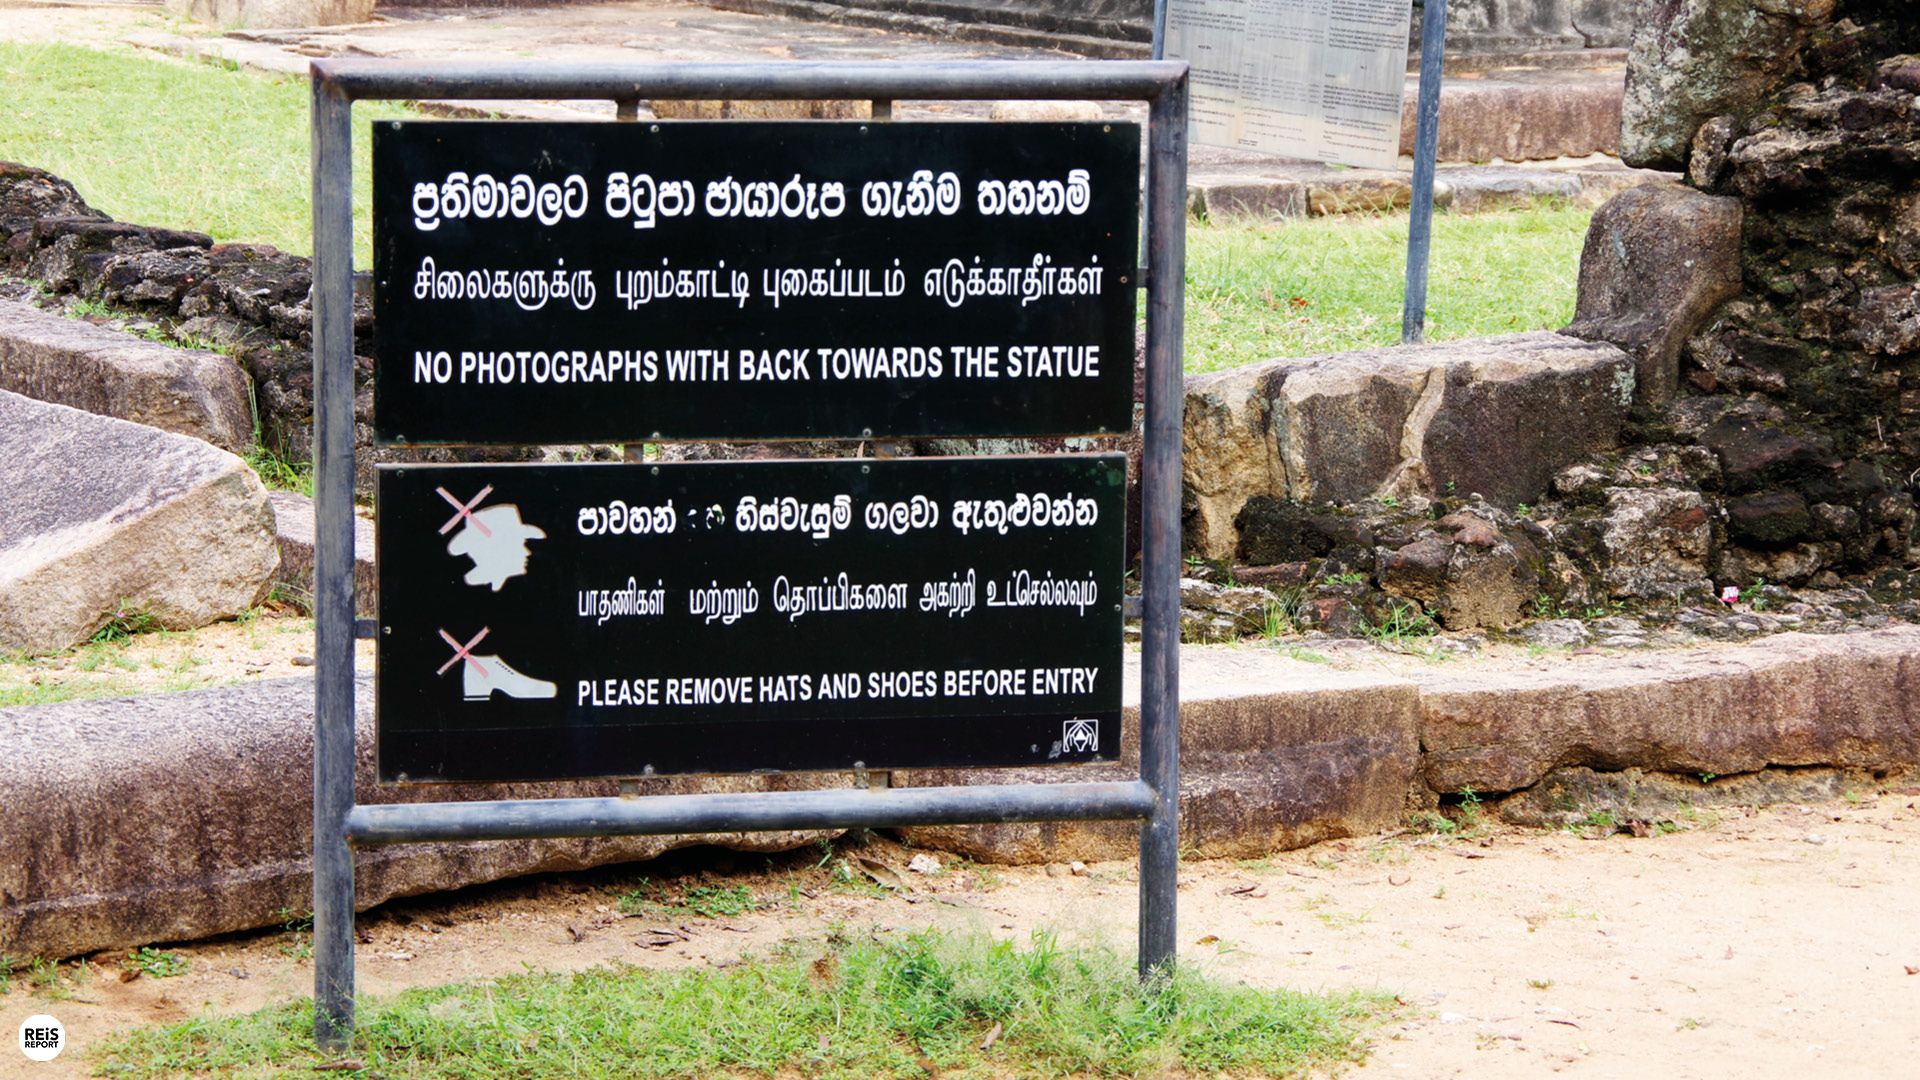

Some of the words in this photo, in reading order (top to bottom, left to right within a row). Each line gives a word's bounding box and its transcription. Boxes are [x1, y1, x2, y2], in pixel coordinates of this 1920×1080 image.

[606, 172, 695, 229] පිටුපා
[862, 170, 961, 218] ගැනීම
[978, 169, 1090, 215] තහනම්
[616, 258, 750, 310] புறம்காட்டி
[764, 258, 905, 308] புகைப்படம்
[924, 253, 1103, 307] எடுக்காதீர்கள்
[415, 351, 452, 383] NO
[461, 350, 658, 383] PHOTOGRAPHS
[666, 350, 728, 381] WITH
[740, 349, 810, 380] BACK
[817, 347, 942, 379] TOWARDS
[951, 346, 999, 377] THE
[1007, 346, 1099, 377] STATUE
[578, 499, 676, 535] පාවහන්
[736, 495, 851, 539] හිස්වැසුම්
[865, 495, 938, 534] ගලවා
[579, 576, 665, 626] பாதணிகள்
[690, 580, 758, 624] மற்றும்
[774, 572, 907, 622] தொப்பிகளை
[920, 568, 975, 617] அகற்றி
[987, 570, 1097, 616] உட்செல்லவும்
[579, 679, 659, 706] PLEASE
[666, 677, 753, 704] REMOVE
[760, 675, 812, 702] HATS
[818, 673, 861, 699] AND
[868, 671, 937, 698] SHOES
[944, 669, 1026, 696] BEFORE
[1033, 668, 1098, 694] ENTRY
